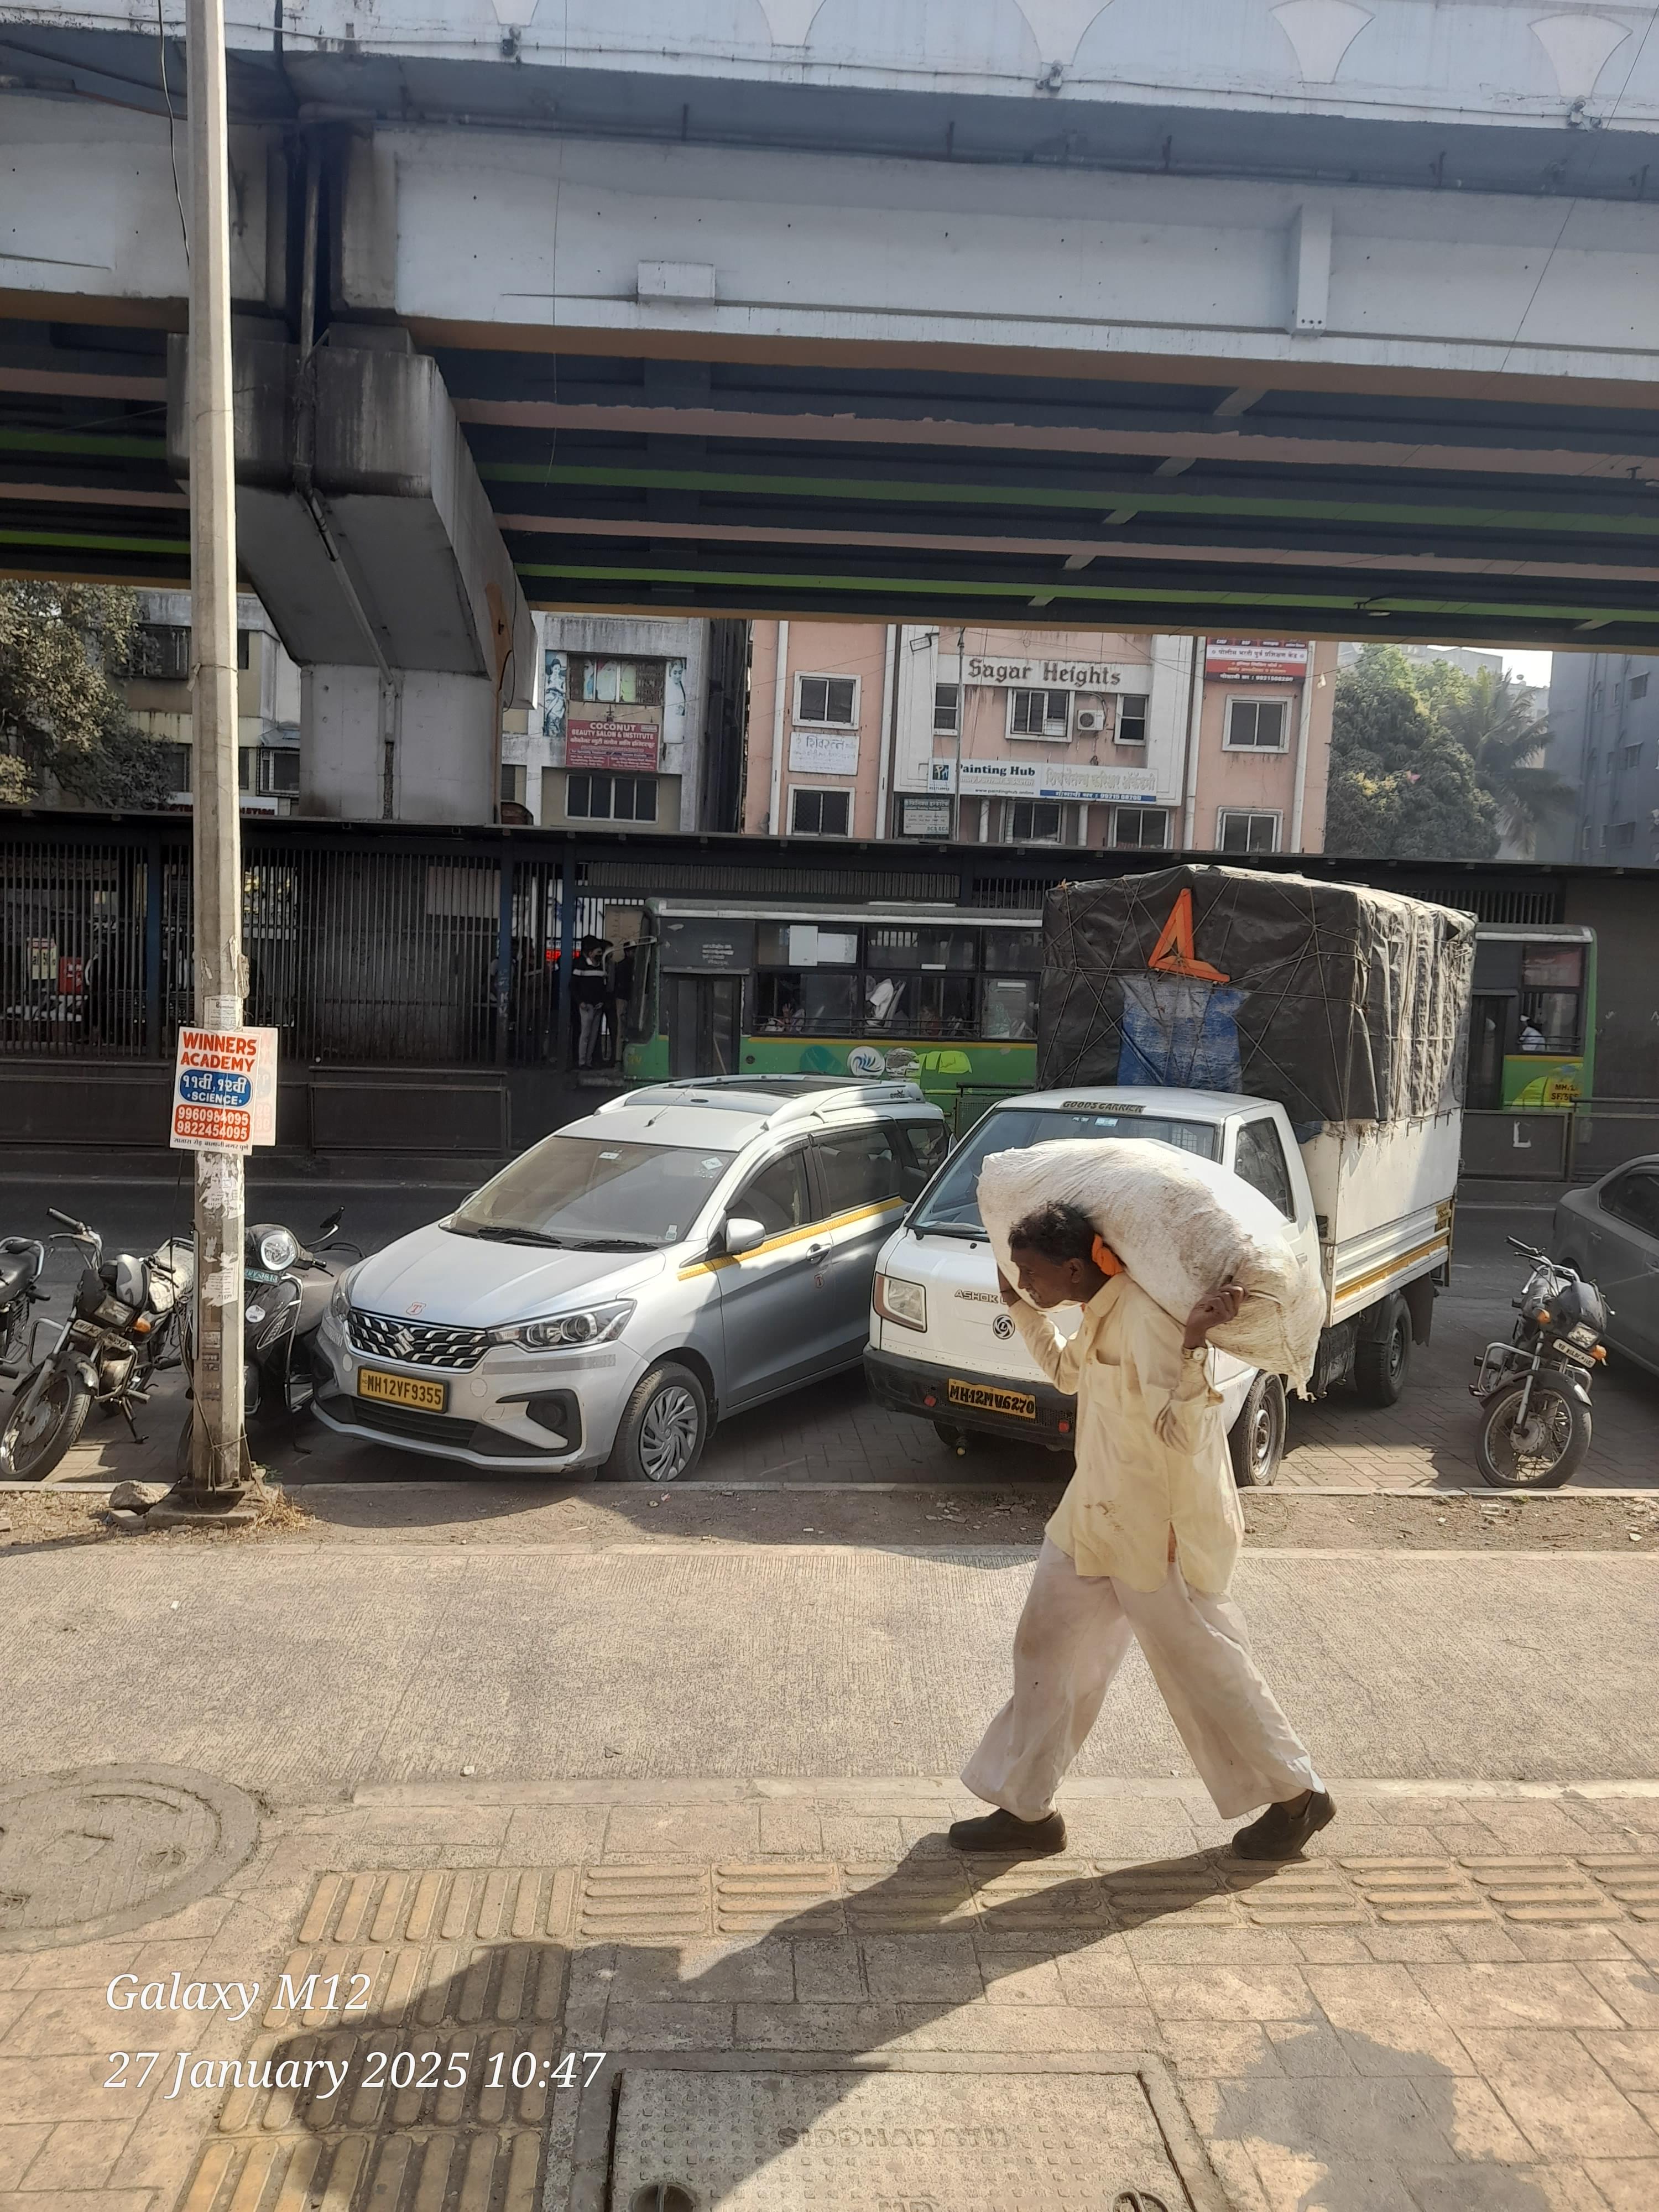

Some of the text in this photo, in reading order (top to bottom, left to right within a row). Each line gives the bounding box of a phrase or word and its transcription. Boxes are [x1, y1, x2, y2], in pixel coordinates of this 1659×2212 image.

[968, 658, 1121, 687] Sagar Heights
[589, 722, 637, 732] COCONUT
[1010, 765, 1036, 776] Hub
[182, 1031, 257, 1056] WINNERS
[180, 1052, 255, 1072] ACADEMY
[191, 1092, 239, 1105] SCIENCE
[1062, 1100, 1146, 1114] GOODS CARRIER
[178, 1107, 248, 1126] 9960984095
[176, 1120, 248, 1140] 9822454095
[954, 1289, 999, 1304] ASHOK
[367, 1375, 442, 1405] MH12VF9355
